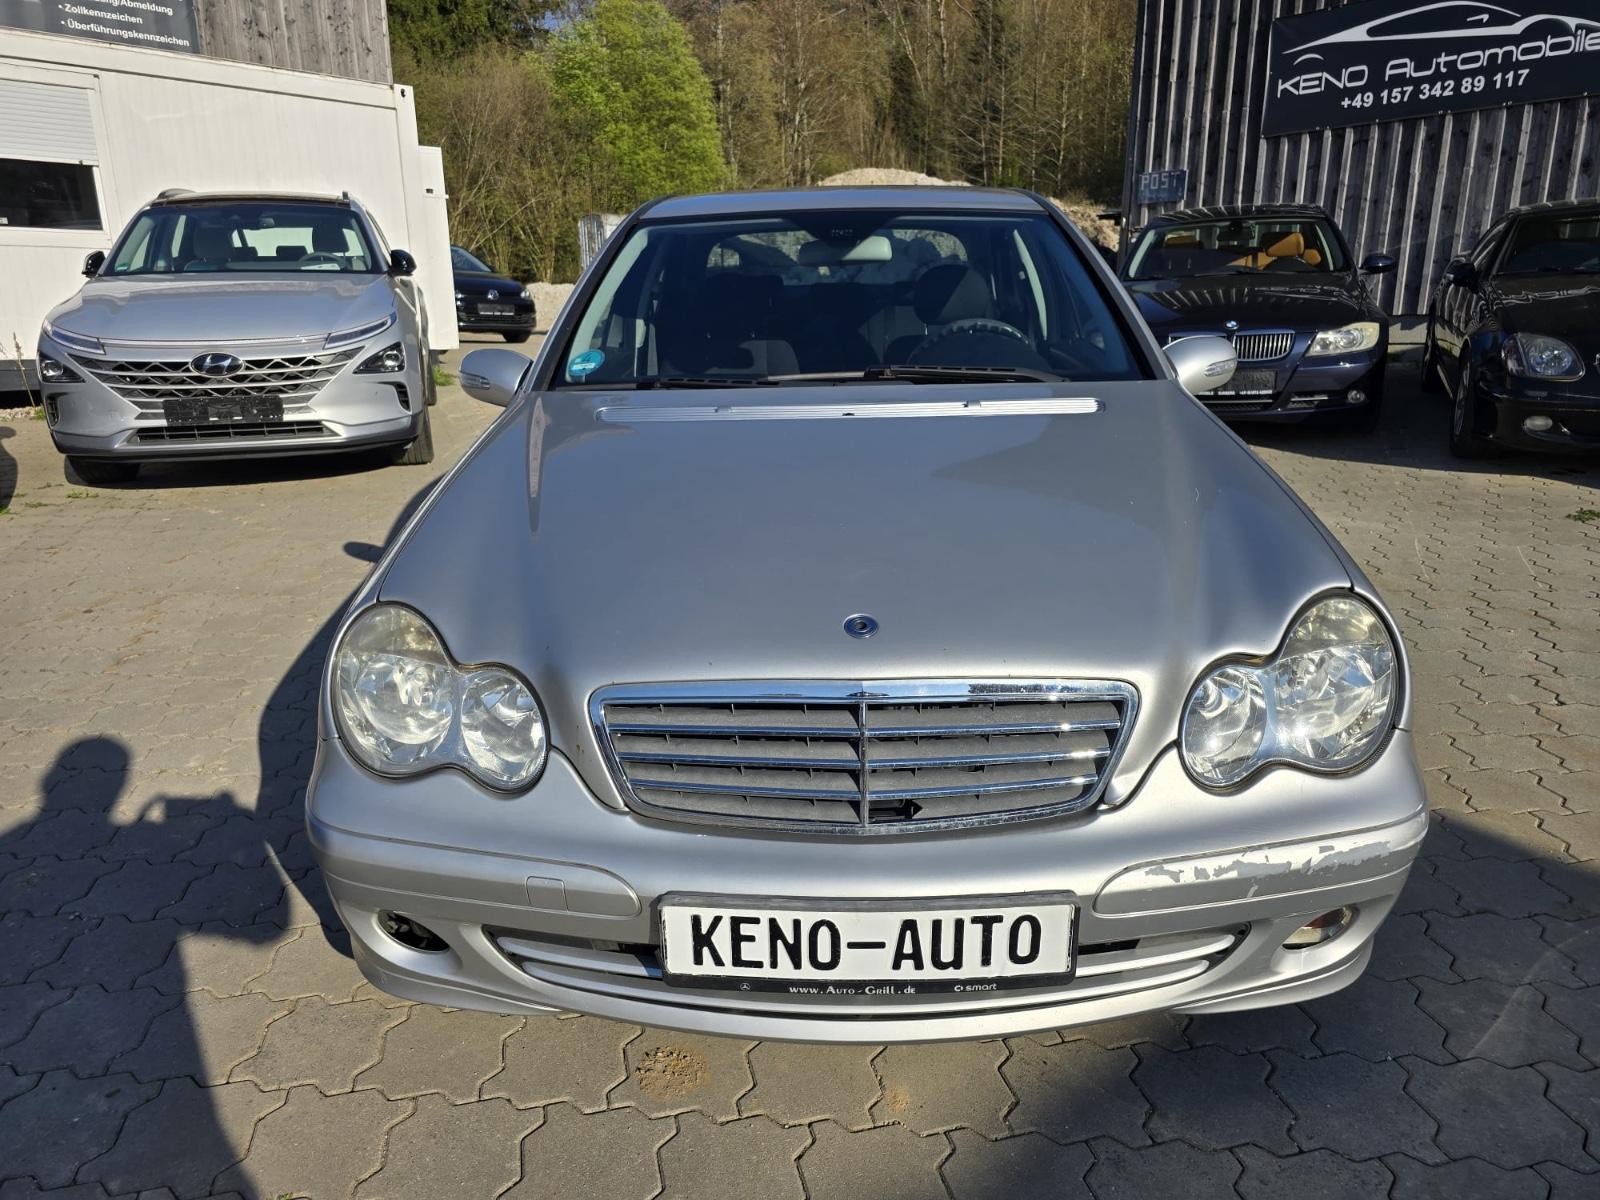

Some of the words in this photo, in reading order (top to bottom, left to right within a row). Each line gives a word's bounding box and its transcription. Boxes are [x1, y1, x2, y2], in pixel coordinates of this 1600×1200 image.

[64, 4, 143, 24] Zollkennzeichen
[67, 19, 190, 46] Überführungskennzeichen
[1277, 65, 1369, 98] KENO
[1341, 92, 1374, 108] +49
[1380, 86, 1414, 104] 157
[1419, 80, 1455, 99] 342
[1460, 75, 1486, 94] 89
[1493, 69, 1530, 89] 117
[1140, 172, 1181, 190] POST
[691, 914, 1042, 971] KENO-AUTO
[965, 983, 998, 991] smart
